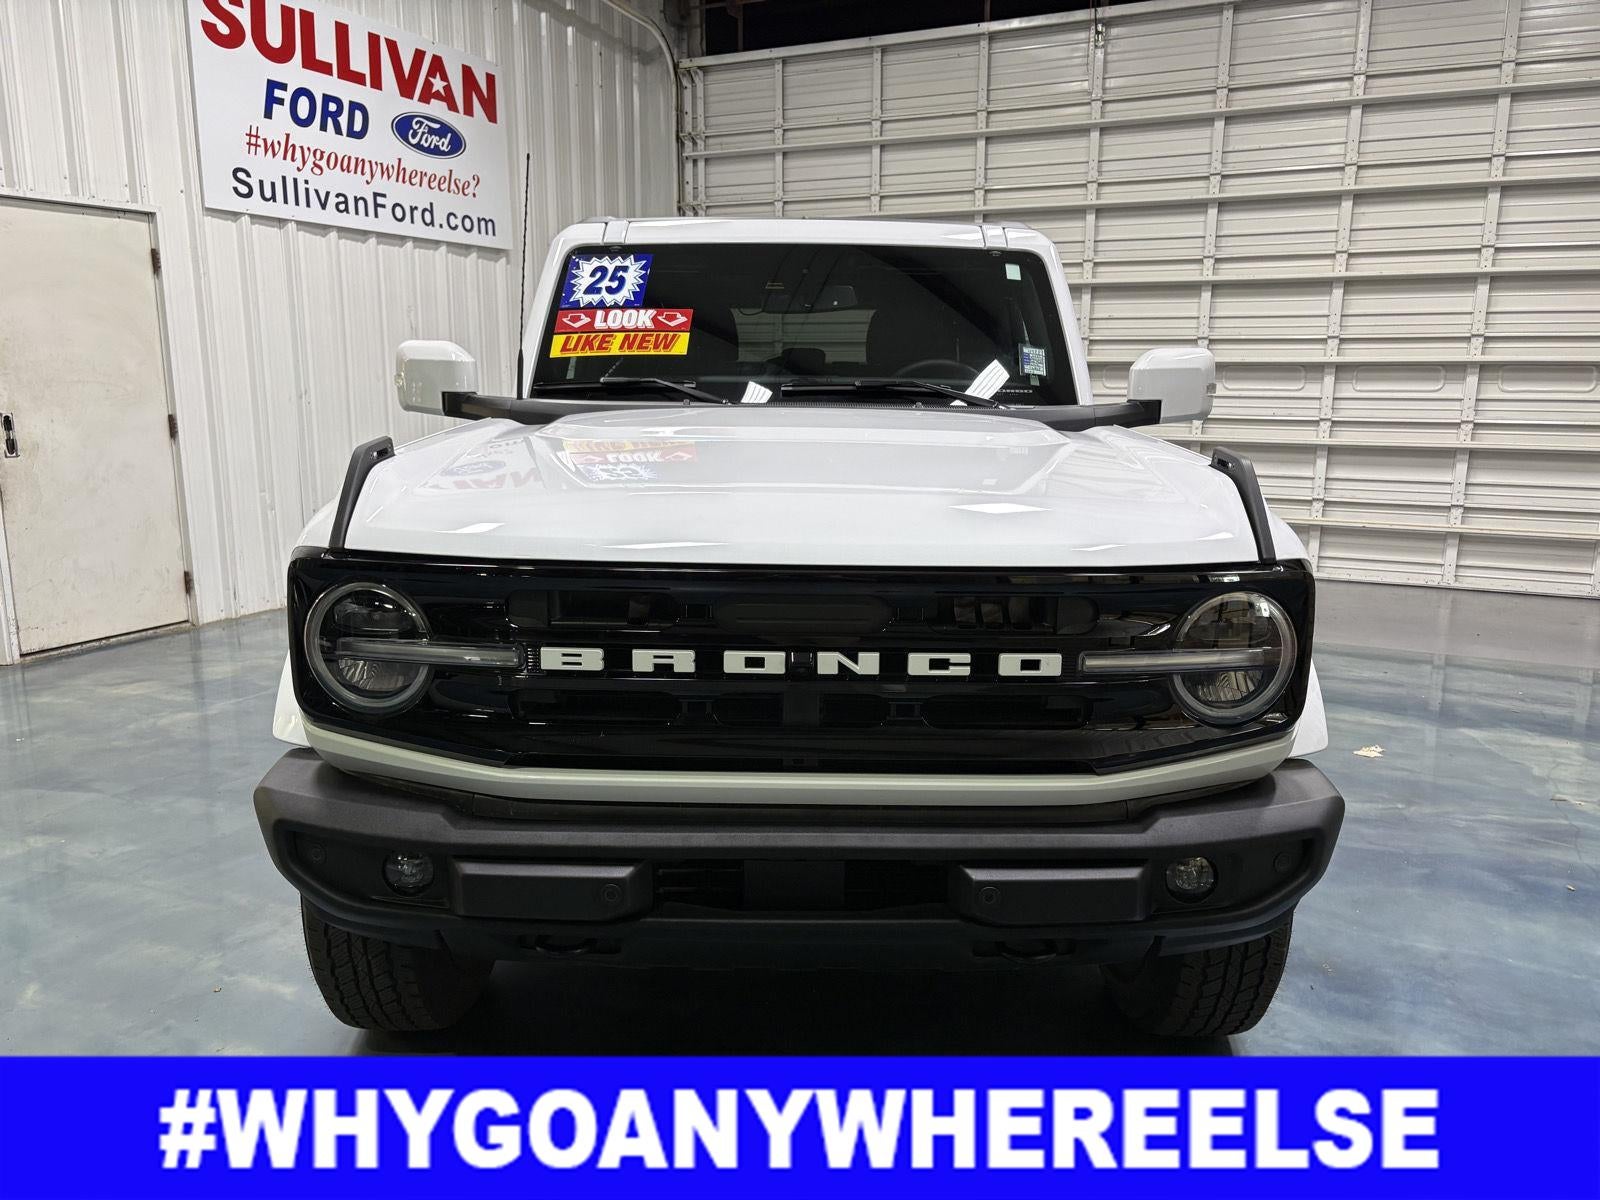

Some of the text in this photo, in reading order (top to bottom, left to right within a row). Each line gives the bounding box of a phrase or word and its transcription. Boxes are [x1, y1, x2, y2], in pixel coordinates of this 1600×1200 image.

[200, 0, 498, 124] SULLIVAN
[263, 78, 369, 140] FORD
[408, 117, 451, 153] Ford
[245, 125, 480, 198] #whygoanywhereelse?
[232, 167, 496, 236] SullivanFord.com
[583, 265, 630, 295] 25
[594, 309, 657, 329] LOOK
[560, 333, 681, 354] LIKE NEW
[540, 646, 1062, 677] BRONCO
